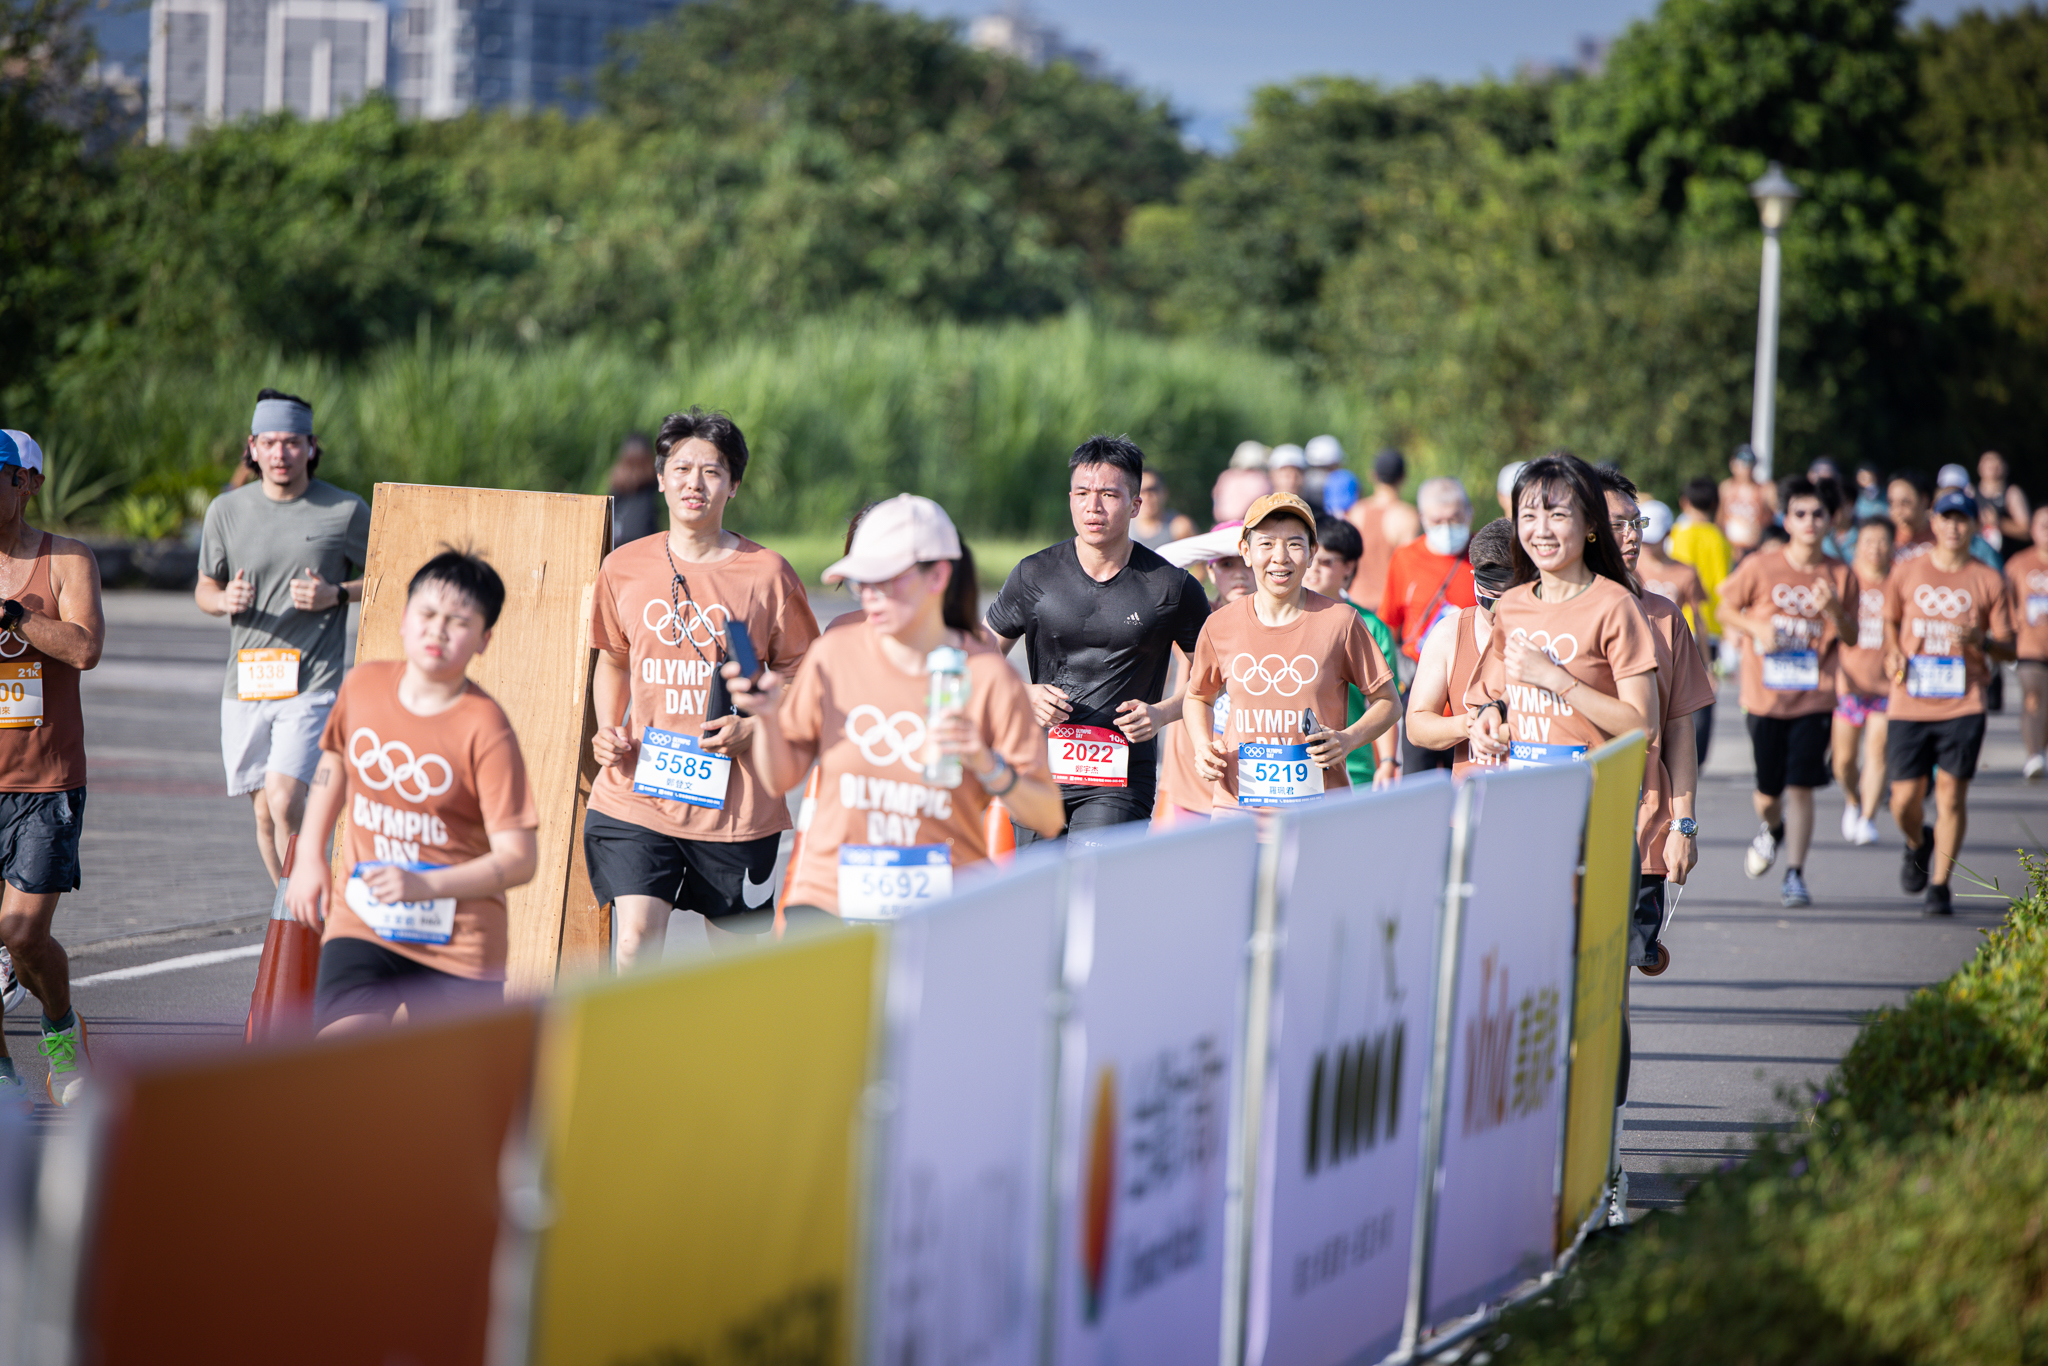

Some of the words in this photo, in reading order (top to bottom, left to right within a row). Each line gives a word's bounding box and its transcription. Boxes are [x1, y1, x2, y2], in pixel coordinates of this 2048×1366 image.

[18, 668, 39, 677] 21K
[249, 664, 284, 680] 1338
[642, 658, 715, 686] OLYMPI
[665, 688, 707, 715] DAY
[1506, 684, 1574, 716] LYMPIC
[1236, 708, 1304, 733] OLYMPI
[1518, 713, 1551, 743] DAY
[1062, 742, 1114, 764] 2022
[1109, 734, 1126, 745] 10K
[655, 751, 713, 780] 5585
[1255, 763, 1308, 783] 5219
[839, 772, 953, 821] OLYMPIC
[353, 792, 449, 846] OLYMPIC
[867, 810, 921, 847] DAY
[373, 833, 421, 866] DAY
[862, 870, 931, 899] 5692
